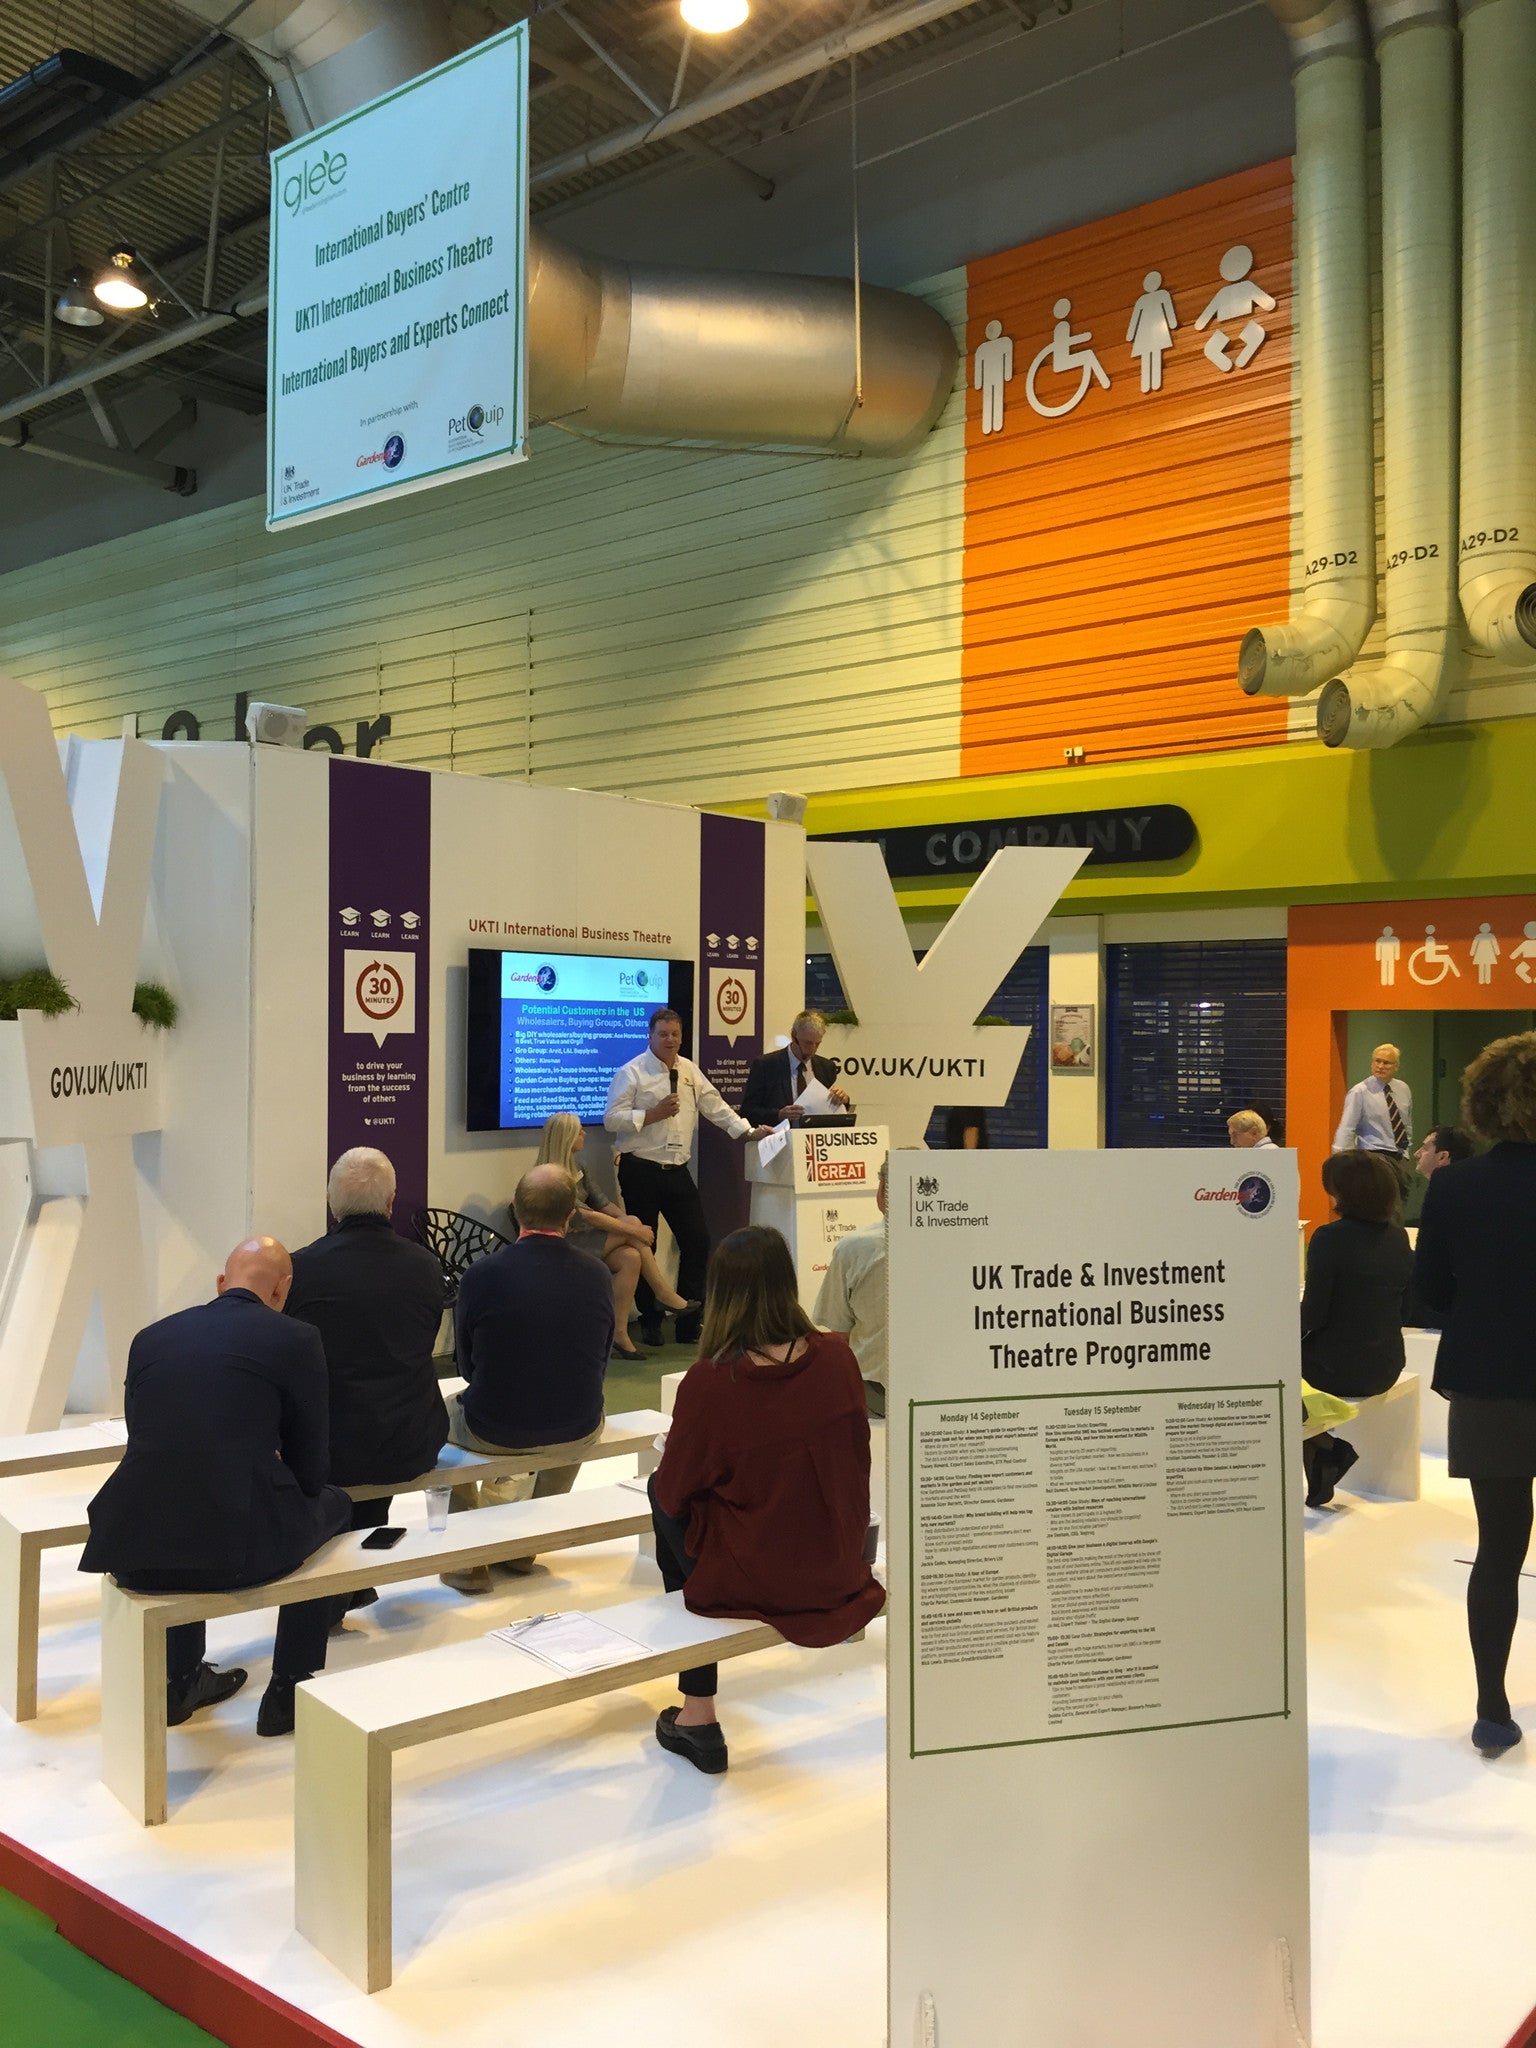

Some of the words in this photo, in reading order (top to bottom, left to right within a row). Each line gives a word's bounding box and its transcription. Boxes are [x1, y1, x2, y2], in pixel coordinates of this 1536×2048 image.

[284, 150, 347, 218] glee
[315, 214, 384, 268] International
[386, 194, 428, 237] Buyers'
[431, 181, 470, 217] Centre
[295, 303, 320, 333] UKTI
[321, 273, 390, 324] International
[393, 255, 444, 294] Business
[446, 235, 494, 271] Theatre
[282, 349, 348, 396] International
[350, 339, 387, 372] Buyers
[390, 325, 410, 355] and
[413, 312, 458, 348] Experts
[461, 289, 509, 330] Connect
[367, 405, 402, 426] partnership
[402, 401, 419, 414] with
[288, 488, 320, 503] Investment
[1460, 527, 1520, 554] A29-D2
[1305, 551, 1358, 579] A29-D2
[1386, 544, 1440, 571] A29-D2
[371, 931, 390, 939] LEARN
[469, 919, 499, 934] UKTI
[503, 921, 579, 939] International
[581, 926, 630, 942] Business
[633, 930, 672, 944] Theatre
[369, 977, 392, 995] 30
[725, 990, 740, 1005] 30
[521, 1004, 560, 1015] Potential
[561, 1005, 607, 1016] Customers
[608, 1006, 616, 1016] in
[616, 1006, 630, 1016] the
[633, 1007, 645, 1017] US
[517, 1017, 567, 1027] Wholesalers,
[568, 1018, 594, 1028] Buying
[595, 1018, 624, 1028] Groups,
[624, 1018, 649, 1028] Others
[515, 1031, 526, 1039] Big
[356, 1062, 364, 1070] to
[366, 1062, 385, 1070] drive
[386, 1062, 403, 1071] your
[829, 1056, 985, 1079] GOV.UK/UKTI
[51, 1060, 148, 1099] GOV.UK/UKTI
[342, 1073, 375, 1081] business
[376, 1073, 386, 1082] by
[387, 1072, 416, 1081] learning
[539, 1076, 558, 1084] Centre
[558, 1076, 578, 1084] Buying
[348, 1084, 366, 1092] from
[367, 1084, 380, 1092] the
[382, 1084, 411, 1092] success
[363, 1095, 371, 1103] of
[372, 1095, 396, 1103] others
[815, 1131, 878, 1147] BUSINESS
[816, 1148, 829, 1162] IS
[819, 1163, 864, 1179] GREAT
[915, 1201, 934, 1212] UK
[936, 1200, 969, 1212] Trade
[825, 1225, 837, 1233] UK
[838, 1223, 857, 1232] Trade
[915, 1215, 925, 1227] &
[927, 1214, 989, 1227] Investment
[972, 1265, 1003, 1290] UK
[1011, 1263, 1073, 1289] Trade
[1080, 1262, 1096, 1288] &
[1103, 1258, 1226, 1287] Investment
[973, 1300, 1122, 1330] International
[1130, 1298, 1225, 1325] Business
[989, 1342, 1078, 1370] Theatre
[1085, 1340, 1212, 1370] Programme
[1064, 1407, 1092, 1416] Tuesday
[1094, 1406, 1102, 1414] 15
[1104, 1404, 1142, 1415] September
[1177, 1401, 1215, 1411] Wednesday
[1217, 1400, 1225, 1408] 16
[1226, 1399, 1264, 1409] September
[940, 1413, 969, 1423] Monday
[970, 1412, 979, 1421] 14
[980, 1410, 1020, 1422] September
